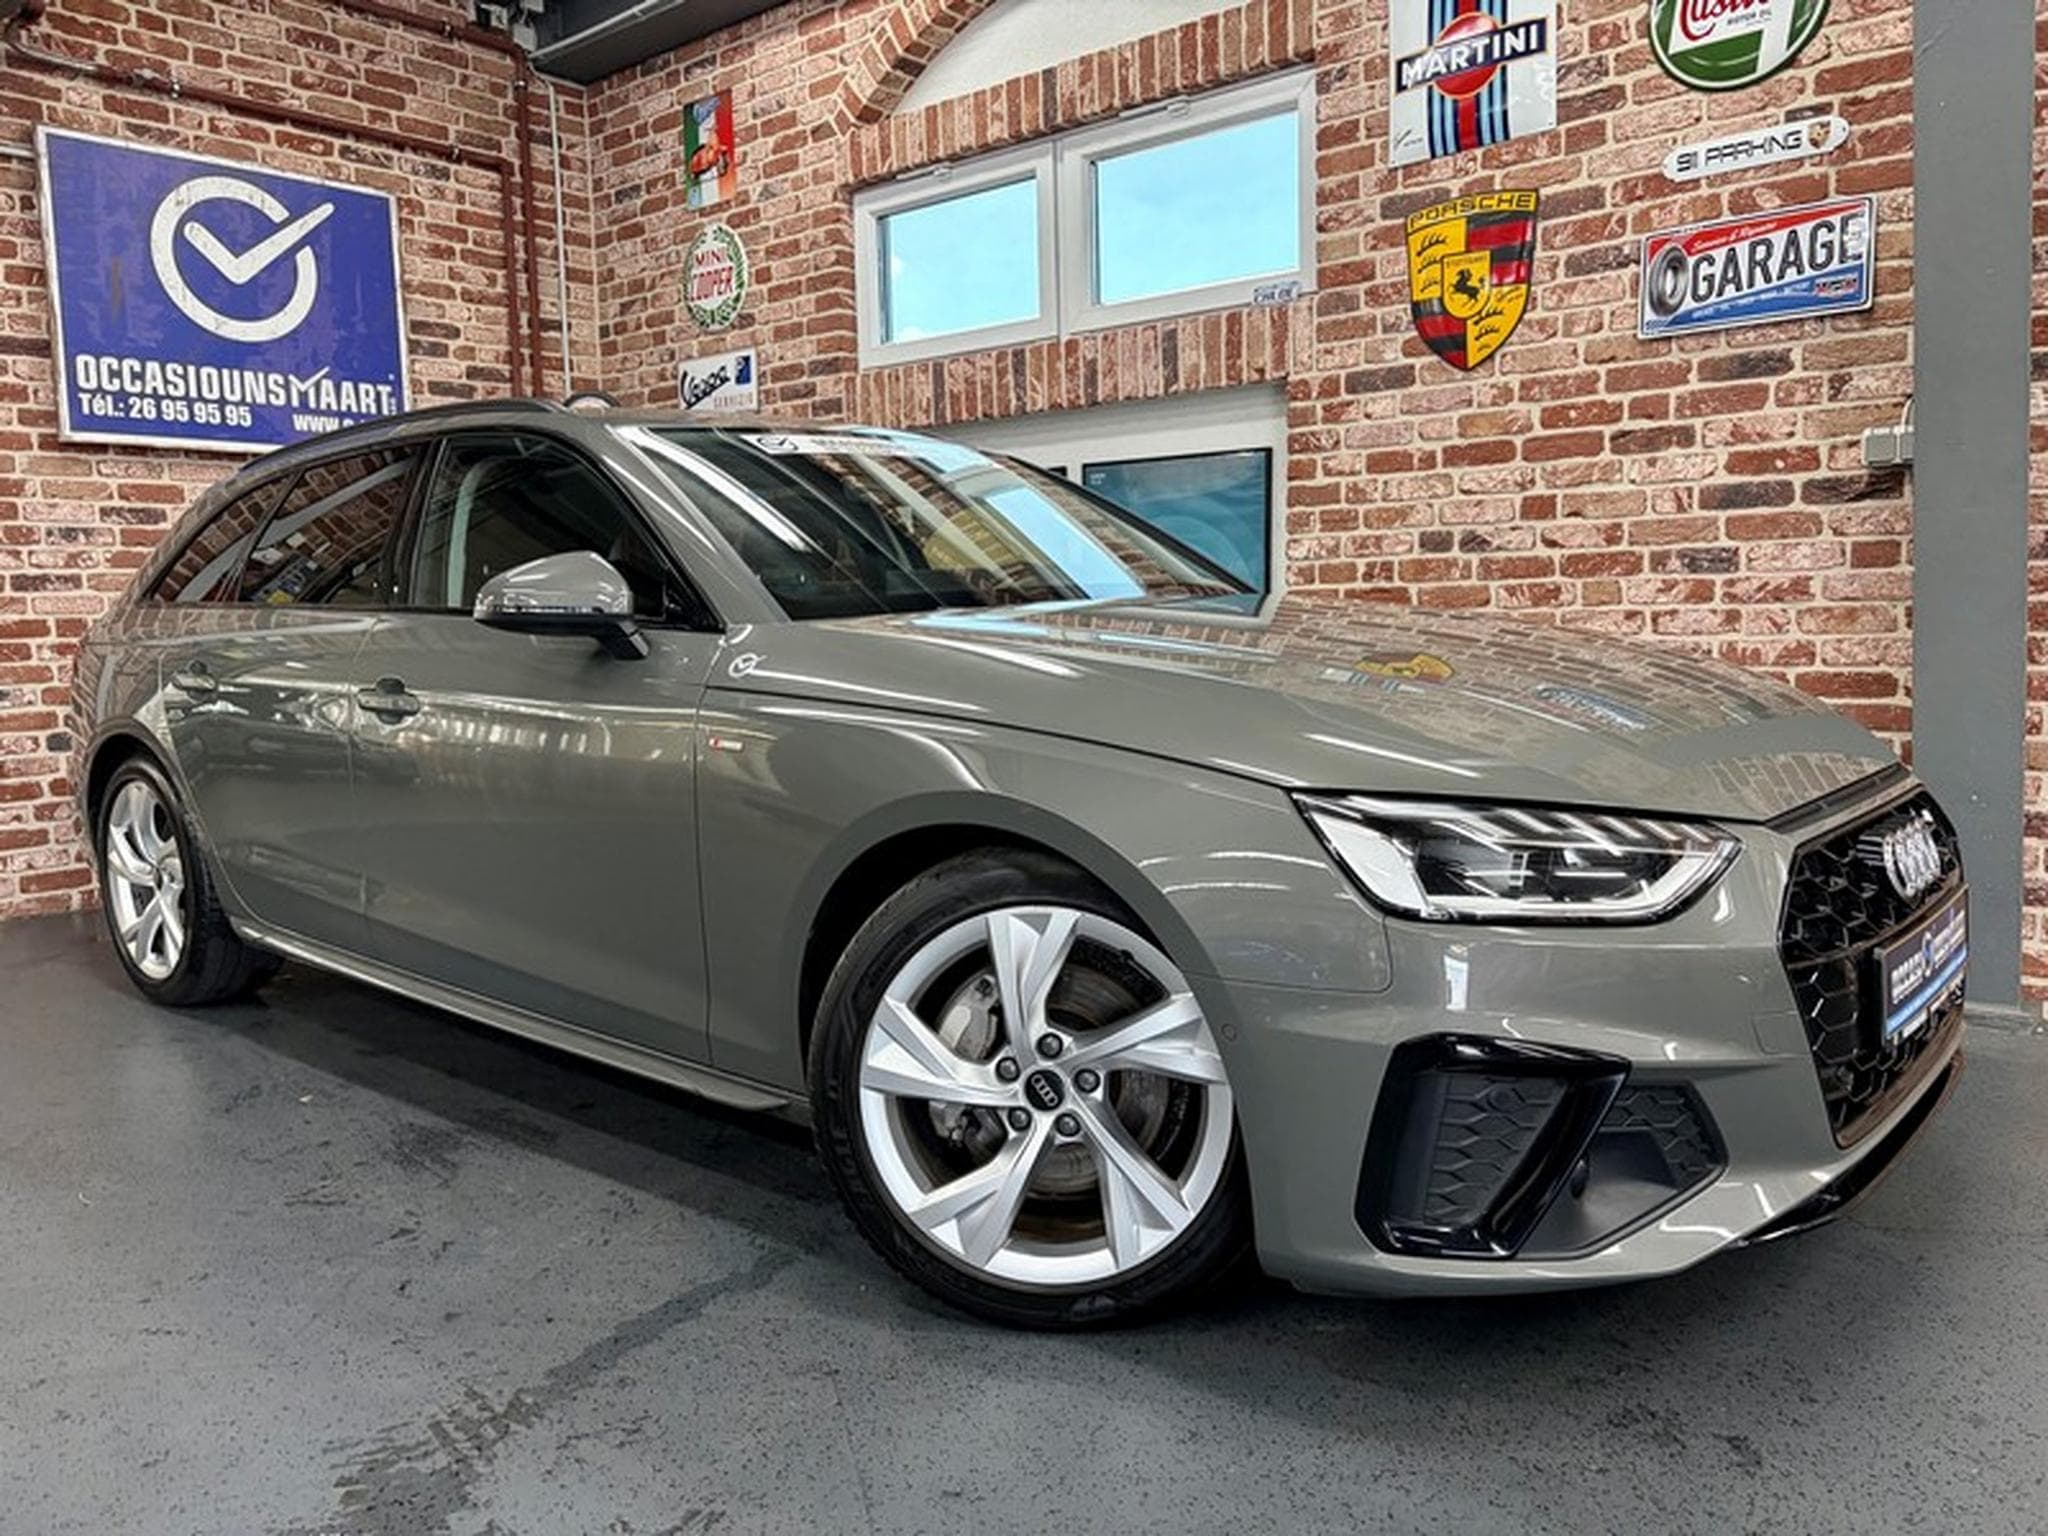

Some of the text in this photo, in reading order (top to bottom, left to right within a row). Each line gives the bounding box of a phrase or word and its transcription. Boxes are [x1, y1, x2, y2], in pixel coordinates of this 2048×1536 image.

[1402, 24, 1538, 89] MARTINI
[1704, 130, 1802, 167] PARKING
[1409, 192, 1532, 229] PORSCHE
[695, 248, 727, 266] MINI
[1690, 210, 1863, 304] GARAGE
[690, 265, 733, 301] COOPER
[76, 354, 392, 416] OCCASIOUNSMAART
[680, 365, 731, 410] Vespa
[79, 393, 252, 428] Tél.: 26 95 95 95
